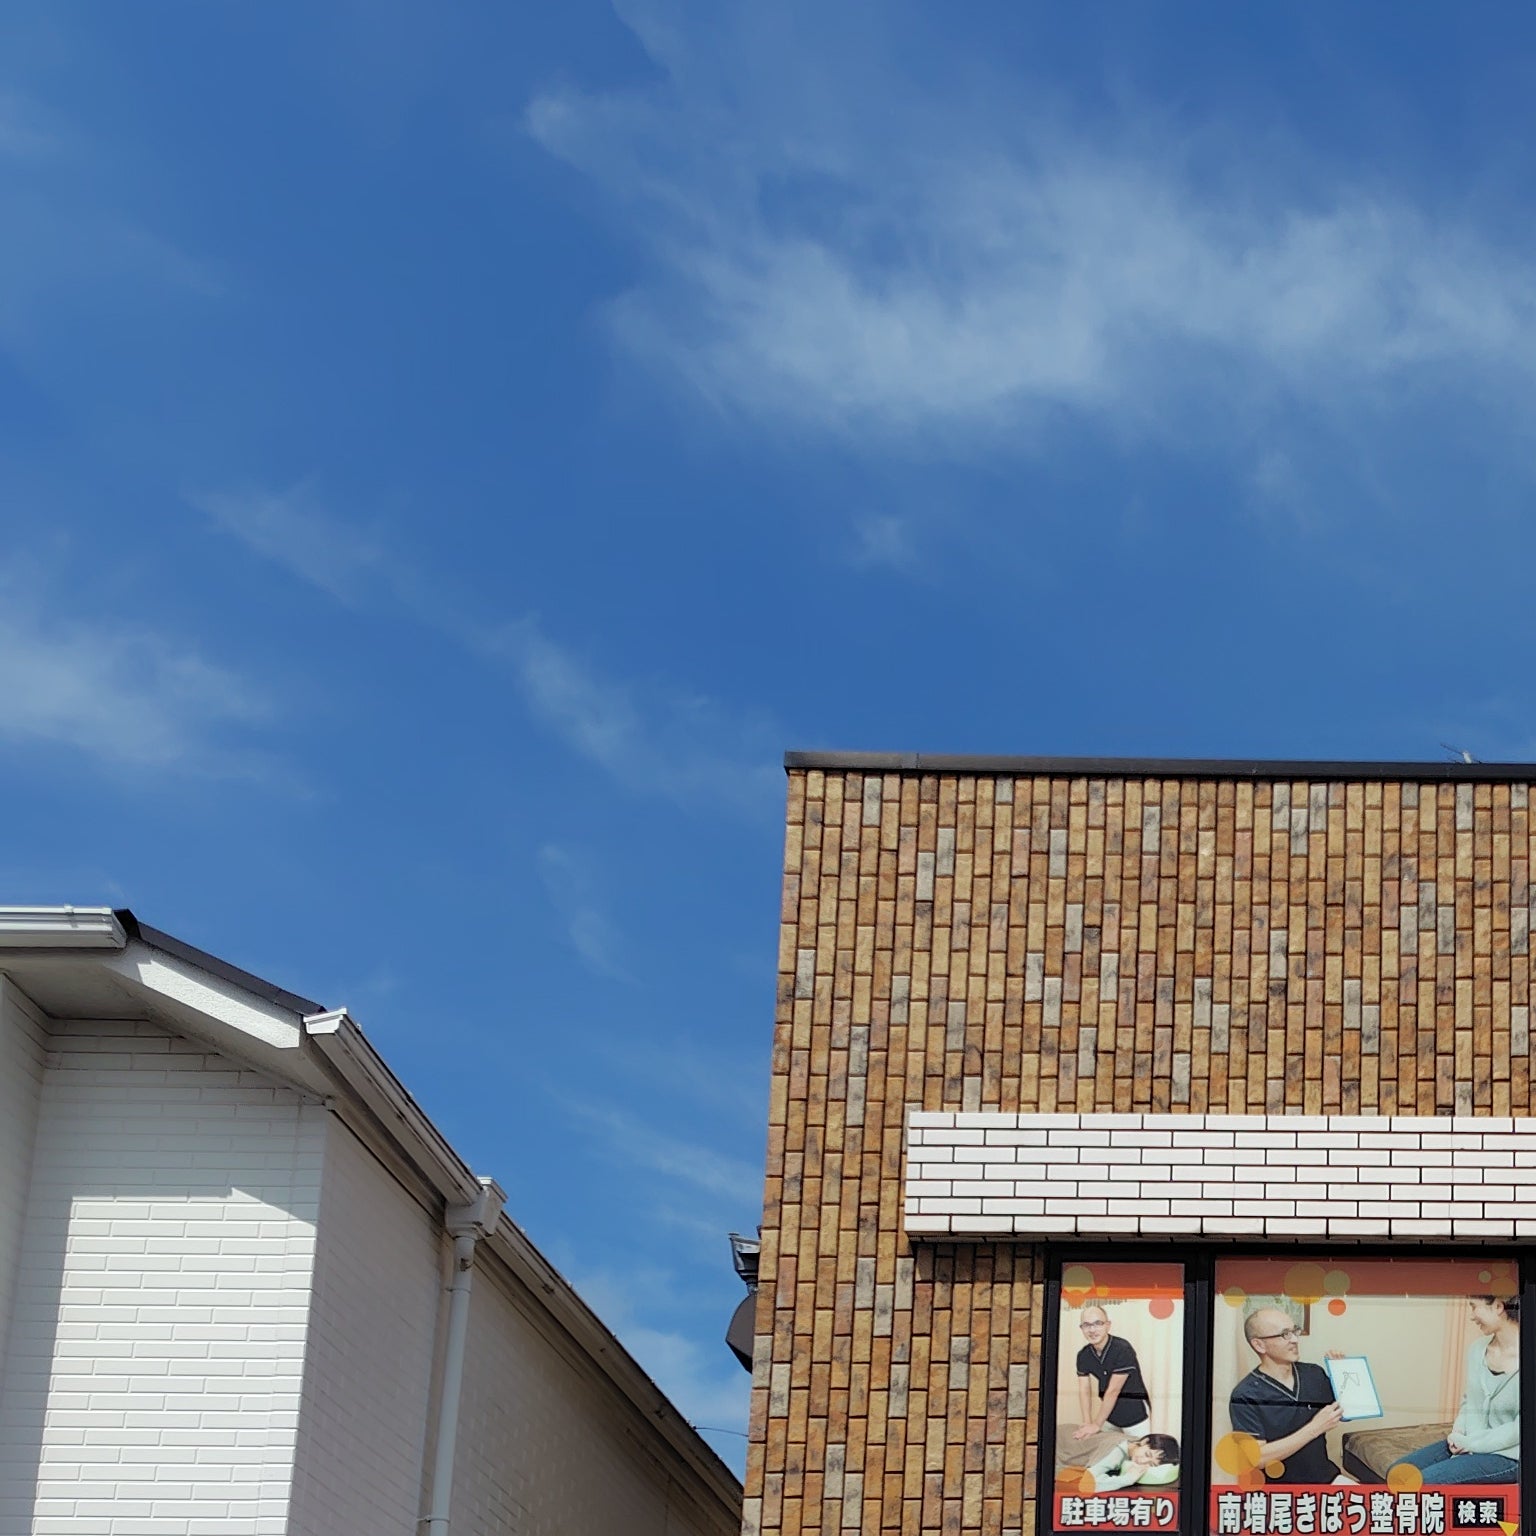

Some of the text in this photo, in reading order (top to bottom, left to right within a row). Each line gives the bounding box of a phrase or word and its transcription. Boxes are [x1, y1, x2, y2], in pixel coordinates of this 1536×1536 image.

[1061, 1496, 1175, 1528] 駐車場有り
[1217, 1492, 1498, 1536] 南増尾きぼう整骨院 検索
